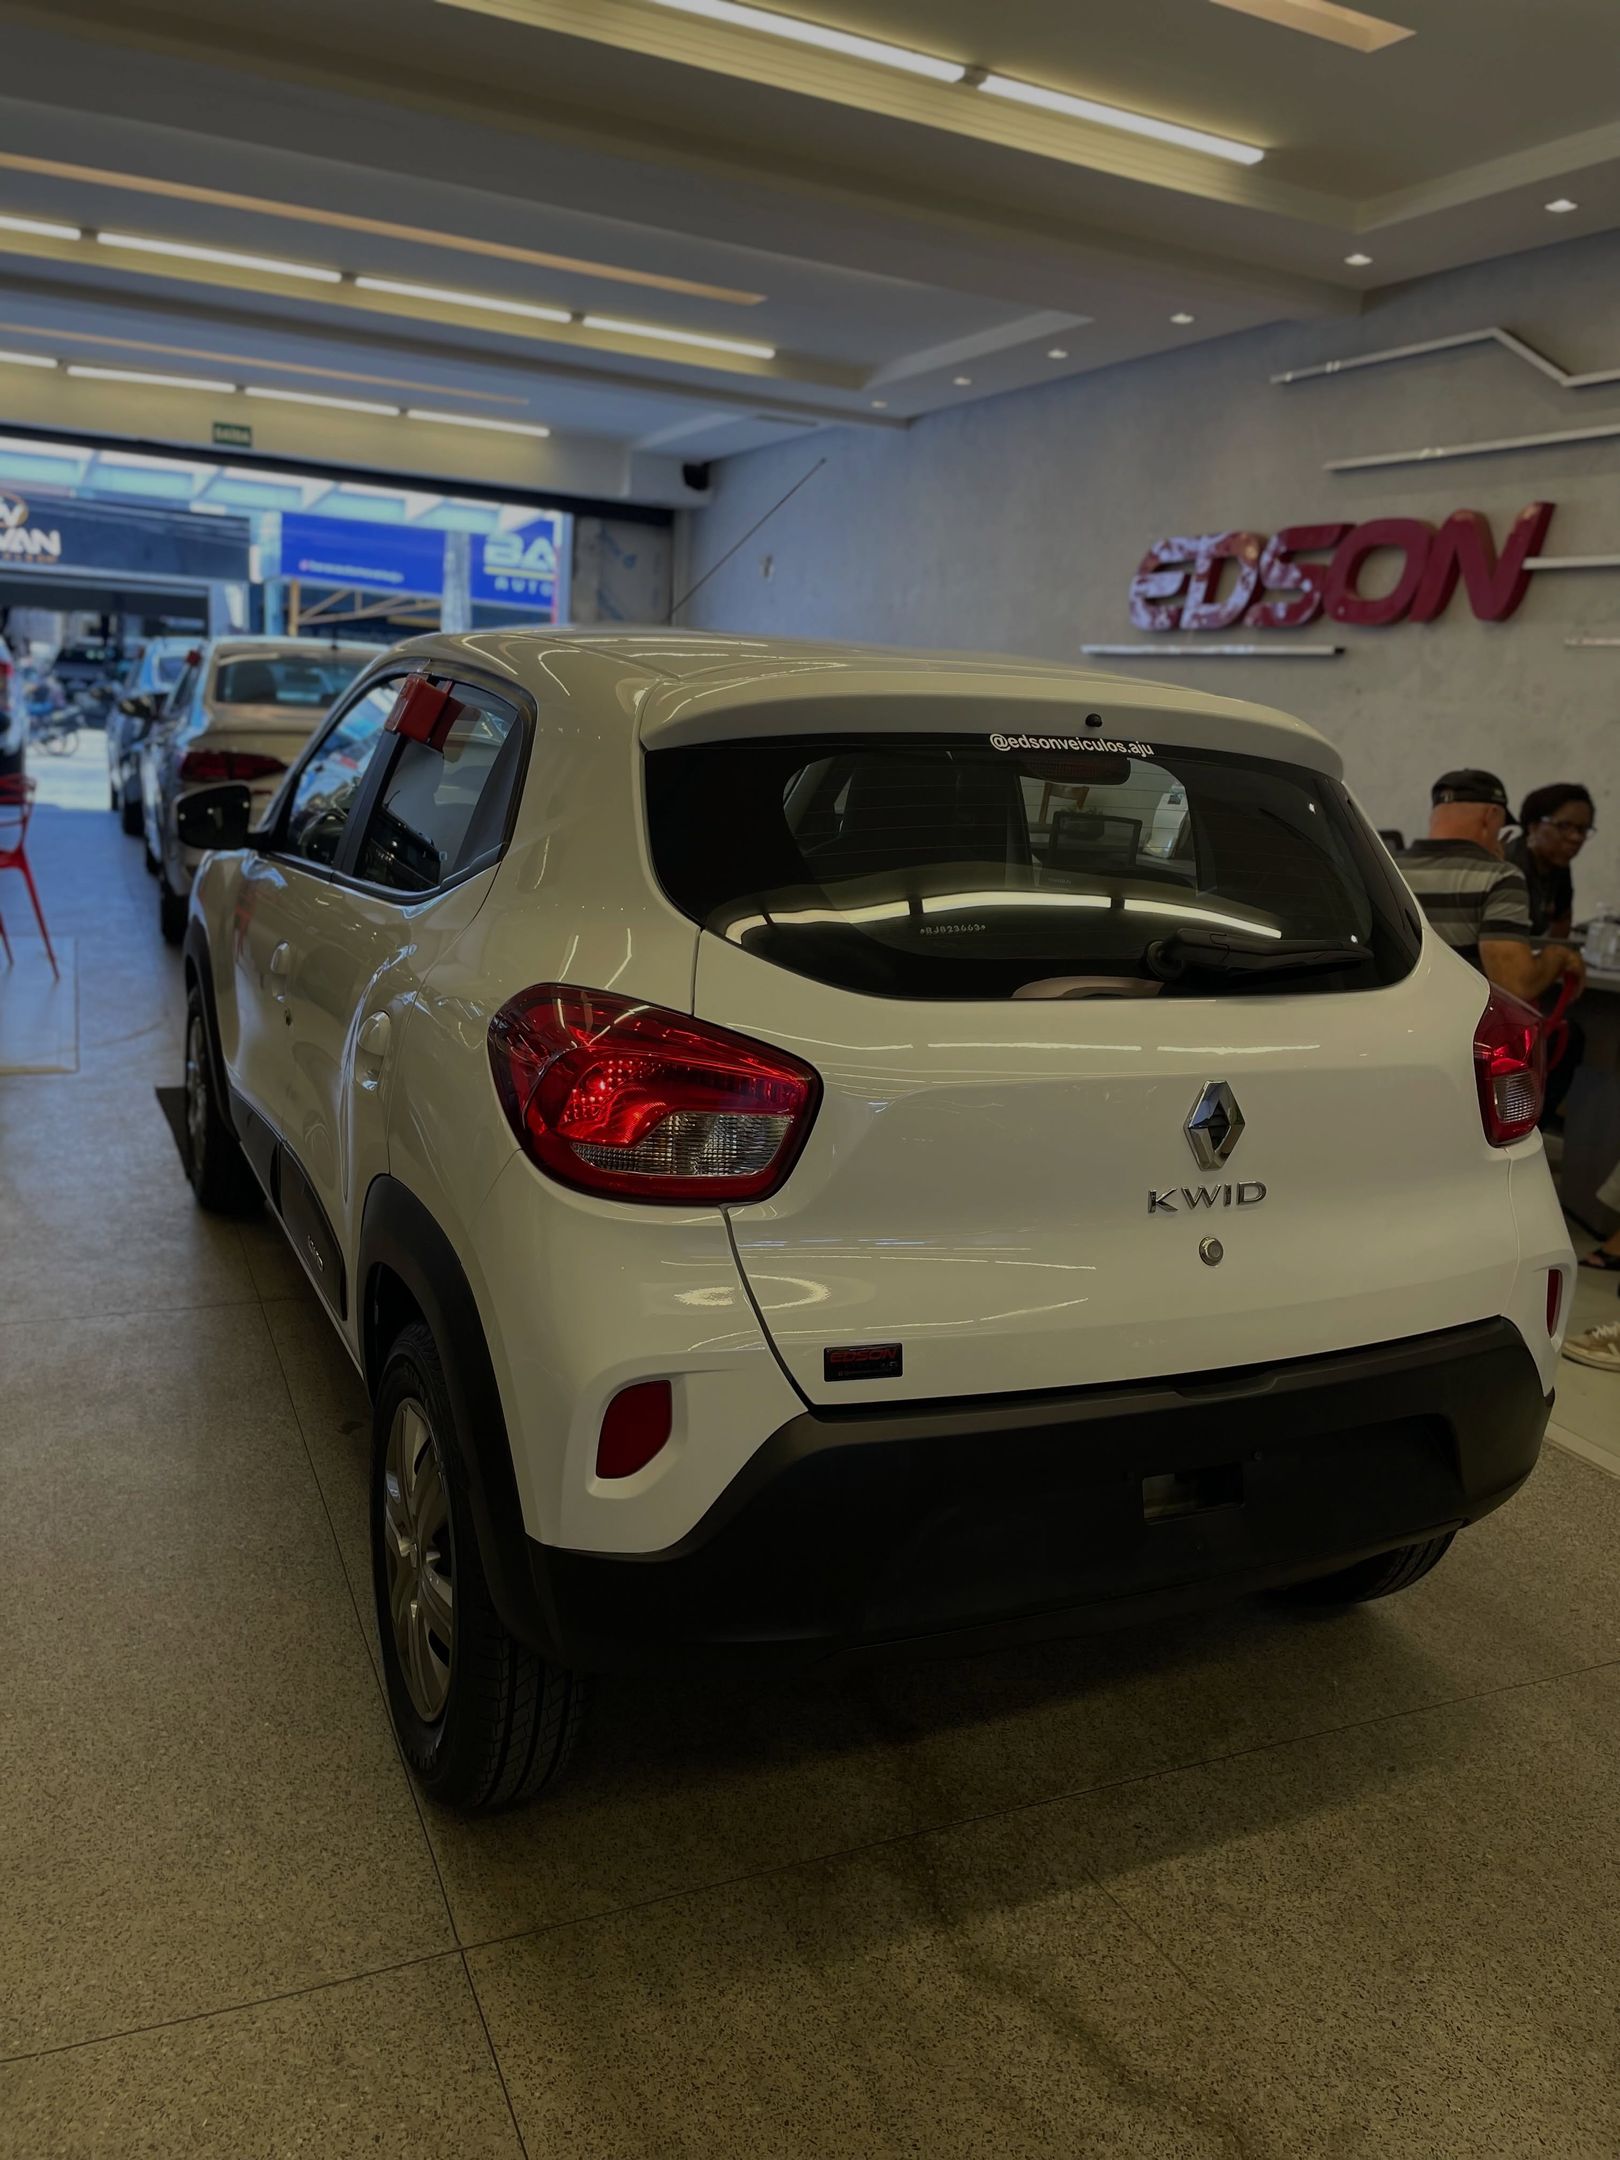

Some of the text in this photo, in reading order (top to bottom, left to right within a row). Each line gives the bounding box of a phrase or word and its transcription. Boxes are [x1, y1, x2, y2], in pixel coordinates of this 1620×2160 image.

[1129, 503, 1556, 631] EDSON
[989, 733, 1155, 757] @edsonveiculos.aju
[1148, 1180, 1267, 1213] KWID
[831, 1348, 897, 1363] EDSON
